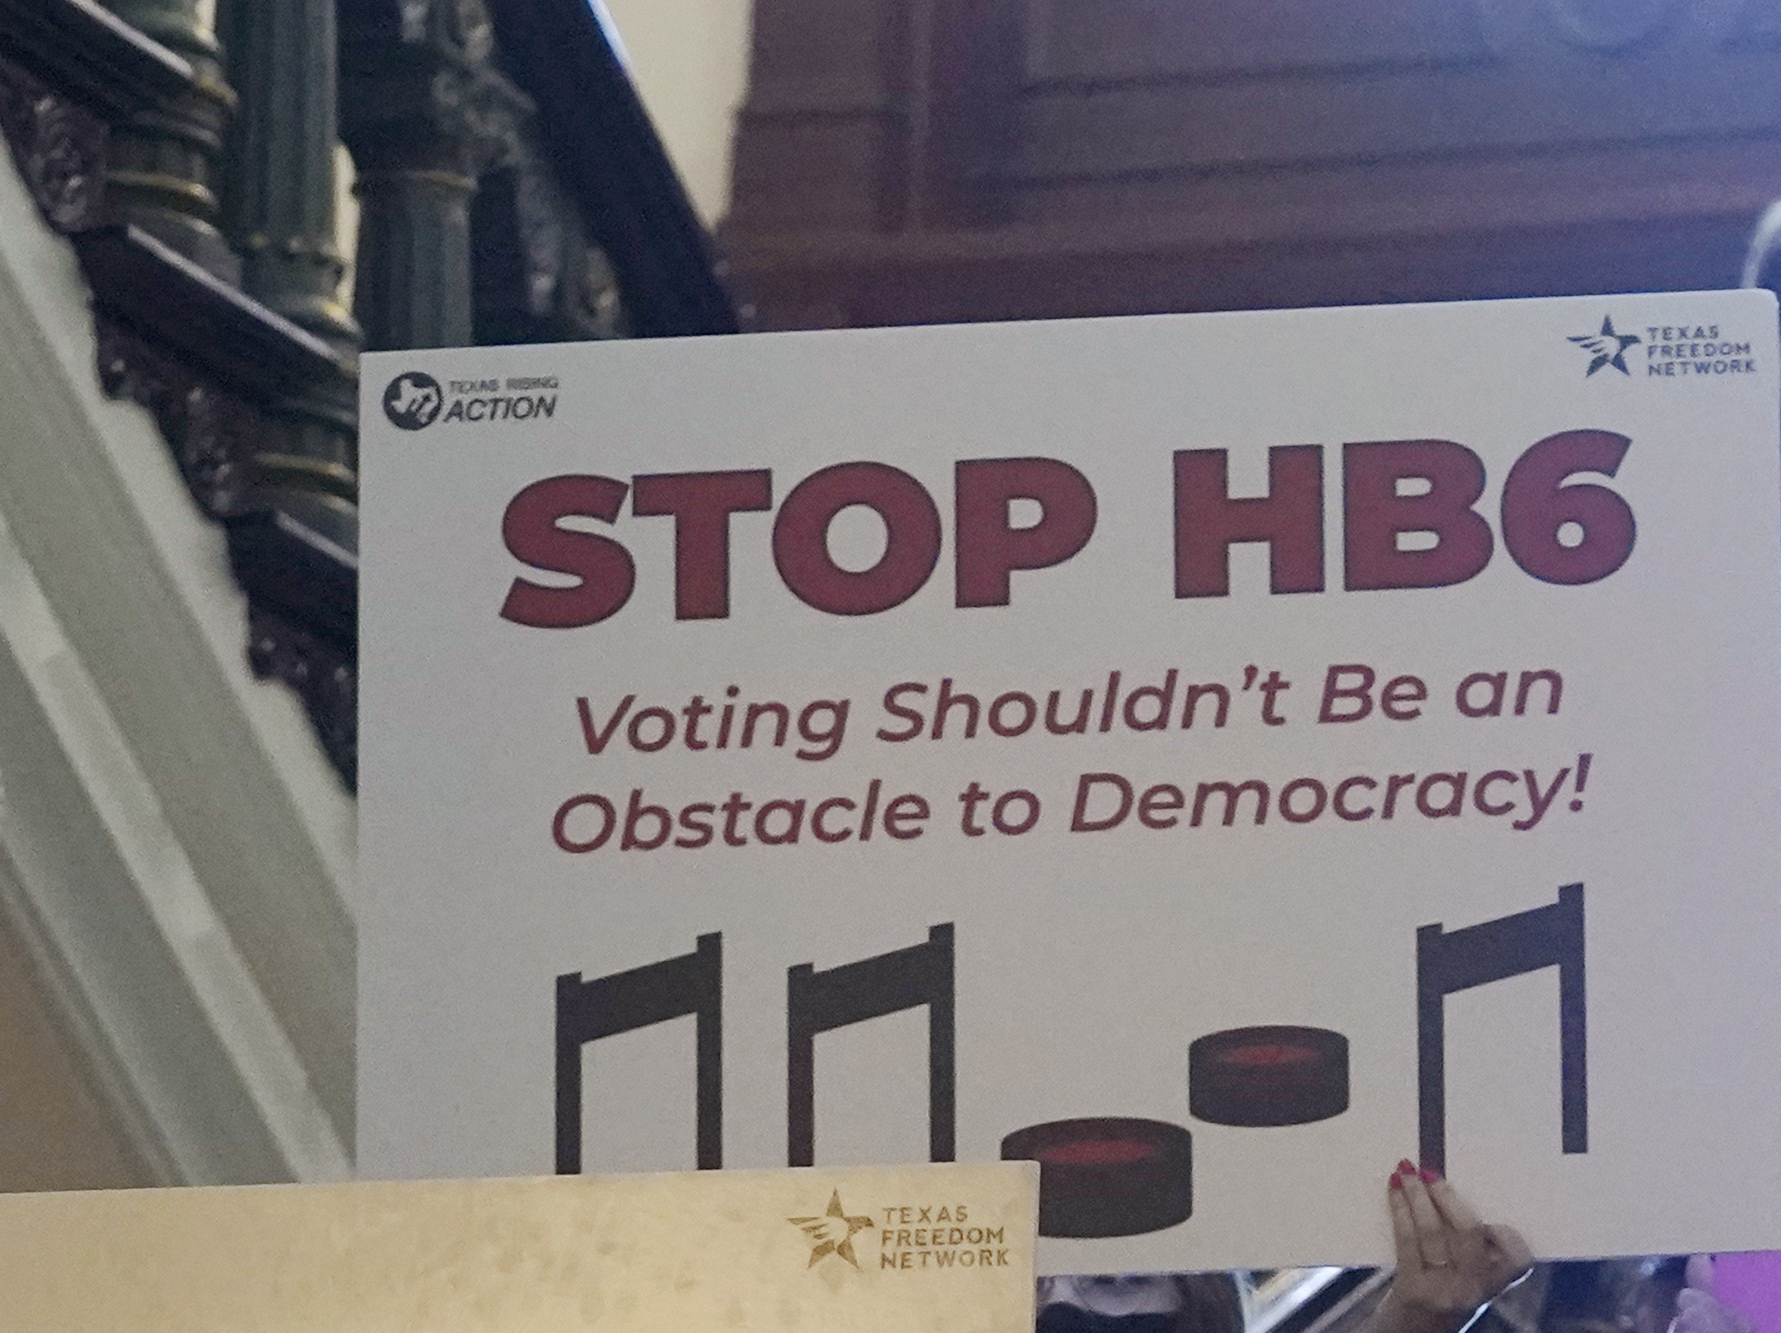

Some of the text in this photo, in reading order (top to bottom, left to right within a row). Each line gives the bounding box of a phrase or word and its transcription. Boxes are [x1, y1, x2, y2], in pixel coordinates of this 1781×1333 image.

[1647, 325, 1720, 342] TEXAS
[1647, 342, 1751, 359] FREEDOM
[1647, 359, 1757, 377] NETWORK
[443, 394, 558, 424] ACTION
[497, 429, 1638, 629] STOP HB6
[574, 661, 1563, 760] Voting Shouldn’t Be an
[548, 752, 1595, 854] Obstacle to Democracy!
[882, 1205, 969, 1225] TEXAS
[881, 1226, 1005, 1247] FREEDOM
[880, 1248, 1010, 1270] NETWORK
